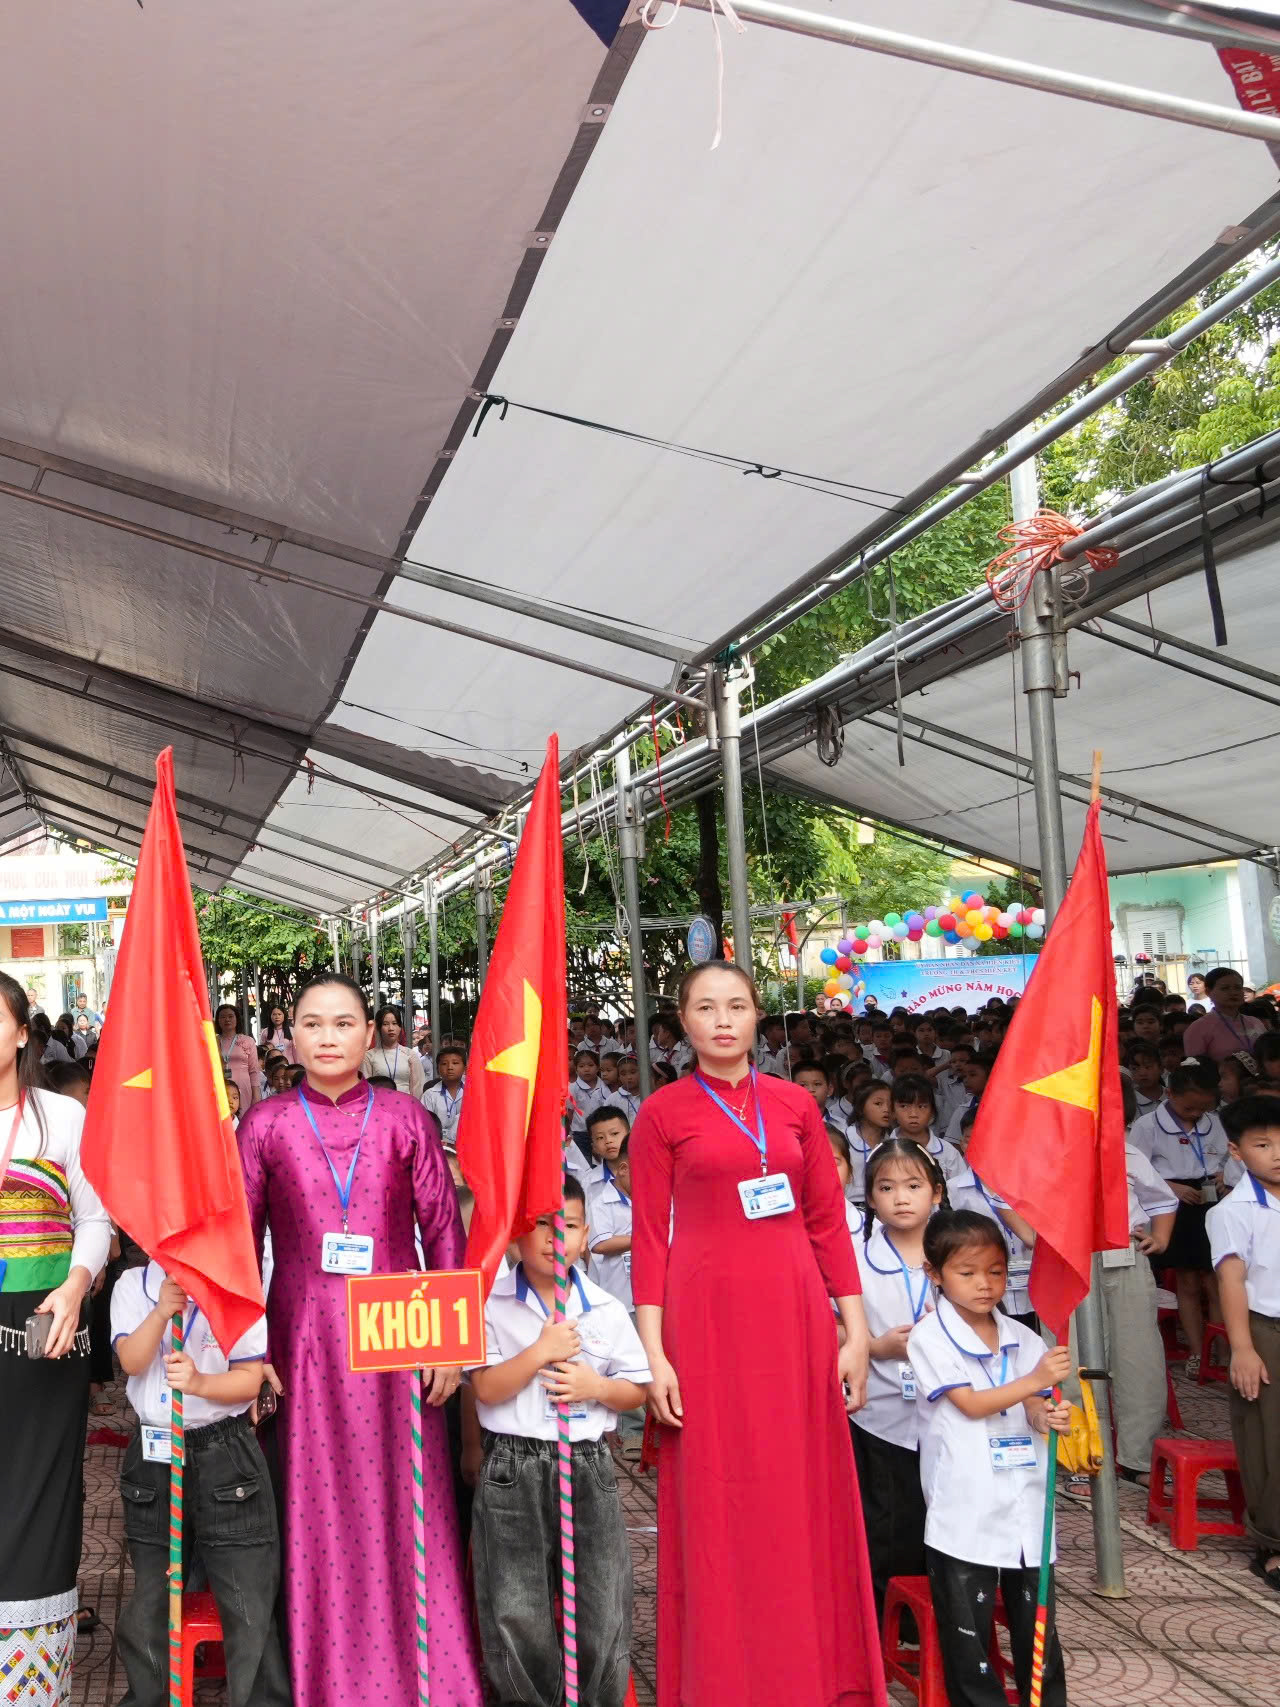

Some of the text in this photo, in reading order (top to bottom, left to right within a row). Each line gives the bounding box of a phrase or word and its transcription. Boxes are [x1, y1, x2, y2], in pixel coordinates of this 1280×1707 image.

[8, 904, 35, 920] MỘT
[37, 903, 72, 918] NGÀY
[74, 903, 96, 915] VUI
[906, 995, 927, 1014] HÀO
[928, 983, 963, 998] MỪNG
[966, 981, 993, 993] NĂM
[358, 1281, 469, 1352] KHỐI 1
